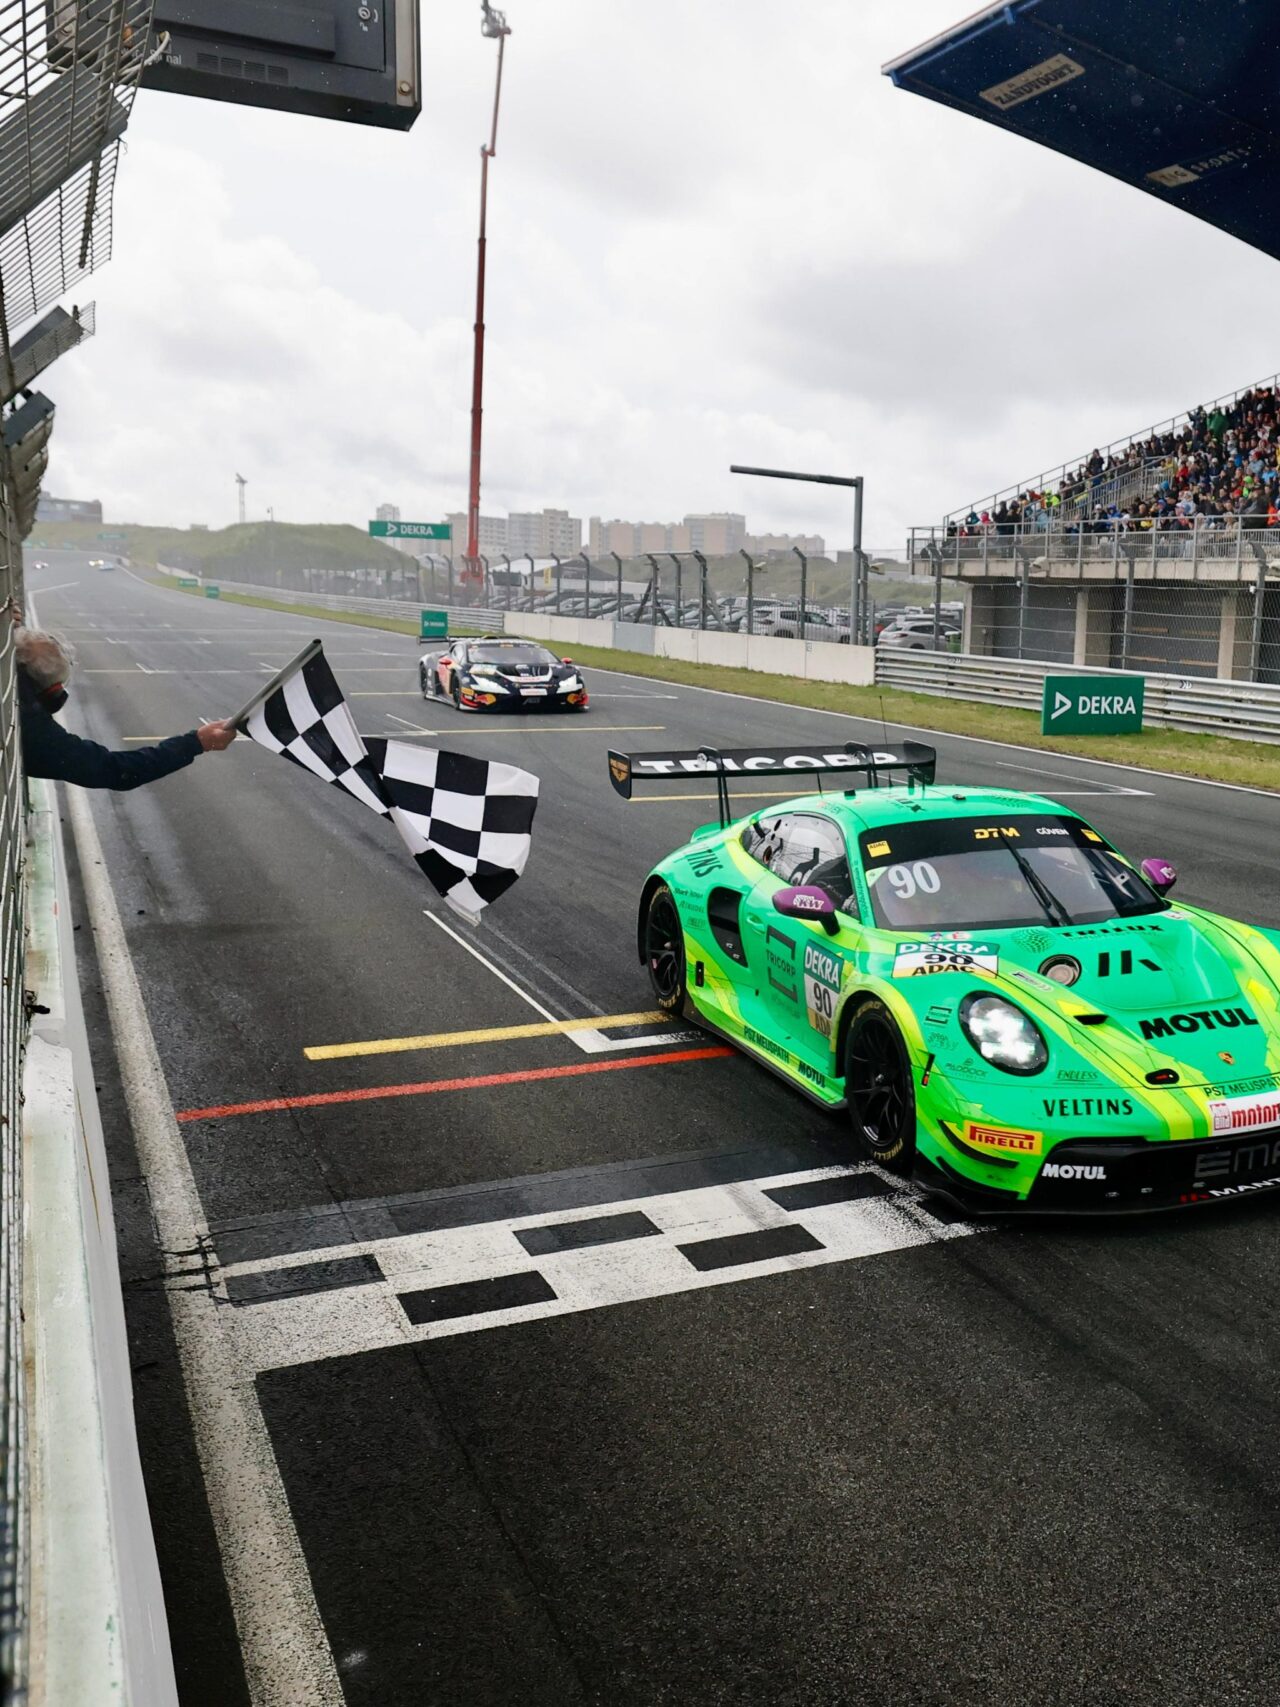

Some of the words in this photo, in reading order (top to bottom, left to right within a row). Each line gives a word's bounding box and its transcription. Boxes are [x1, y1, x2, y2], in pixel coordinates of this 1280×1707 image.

[400, 524, 434, 537] DEKRA
[1078, 695, 1137, 715] DEKRA
[974, 827, 1021, 839] DTM
[887, 861, 942, 899] 90
[899, 942, 990, 954] DEKRA
[766, 949, 796, 977] TRICORP
[804, 945, 840, 988] DEKRA
[924, 953, 974, 965] 90
[911, 964, 976, 976] ADAC
[813, 982, 832, 1019] 90
[1138, 1008, 1260, 1041] MOTUL
[798, 1060, 826, 1088] MOTUL
[1203, 1085, 1228, 1098] PSZ
[1043, 1099, 1133, 1117] VELTINS
[969, 1125, 1036, 1150] PIRELLI
[1041, 1163, 1107, 1180] MOTUL
